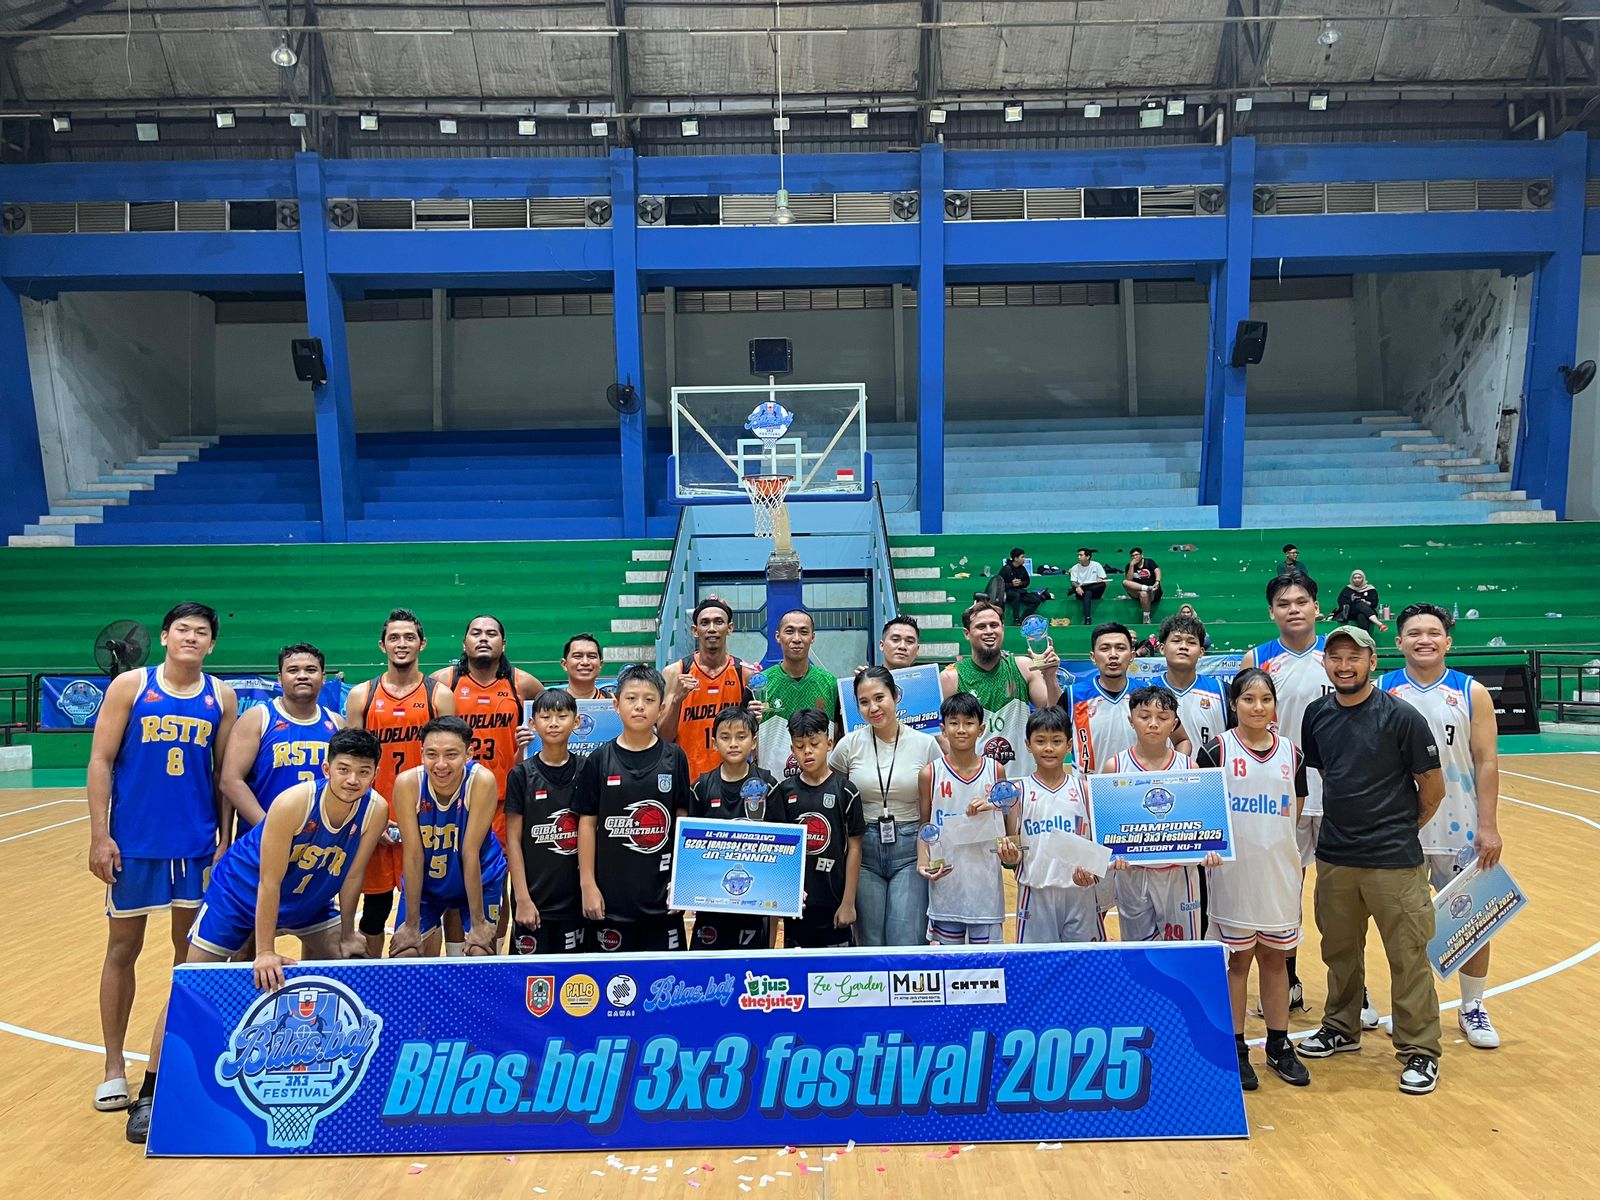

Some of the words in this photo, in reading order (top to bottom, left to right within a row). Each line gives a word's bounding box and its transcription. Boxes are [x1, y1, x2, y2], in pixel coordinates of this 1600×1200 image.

[459, 712, 514, 730] ALDELAPAN
[988, 716, 1005, 733] 10
[141, 714, 212, 748] RSTR
[370, 725, 424, 744] ALDELAPA
[1201, 727, 1209, 745] 6
[1445, 724, 1455, 745] 3
[166, 747, 184, 776] 8
[273, 741, 329, 769] RST
[392, 751, 405, 775] 7
[784, 769, 801, 777] GOA
[1233, 757, 1247, 777] 13
[940, 781, 953, 798] 14
[1030, 790, 1037, 801] 2
[533, 825, 557, 835] CIBA
[606, 818, 634, 828] CIBA
[613, 826, 665, 836] BASKETBALL
[1121, 821, 1202, 833] CHAMPIONS
[685, 838, 708, 849] 2025
[708, 840, 741, 851] Festival
[731, 832, 776, 842] CATEGORY
[1104, 833, 1142, 845] Bilas.bdj
[1143, 832, 1160, 842] 3x3
[1162, 831, 1198, 842] Festival
[1198, 829, 1222, 840] 2025
[702, 850, 777, 863] RUNNER-UP
[742, 844, 758, 853] 3x3
[758, 841, 796, 855] Bilas.bdj
[1126, 844, 1174, 853] CATEGORY
[429, 854, 447, 879] 5
[659, 853, 671, 872] 2
[815, 857, 836, 873] 89
[293, 874, 314, 894] 1
[1497, 898, 1519, 920] PUTRA
[1446, 910, 1484, 948] RUNNER
[1484, 896, 1498, 912] UP
[1475, 905, 1501, 931] Festival
[565, 928, 585, 950] 34
[668, 929, 680, 949] 2
[739, 929, 756, 945] 17
[566, 983, 595, 998] PAL8
[761, 977, 788, 992] jus
[835, 975, 886, 1003] Garden
[893, 972, 940, 993] MJU
[643, 973, 736, 1012] Bilas.bdj
[741, 994, 803, 1010] thejuicy
[221, 1015, 378, 1079] Bilas.bdj
[285, 1076, 309, 1087] 3X3
[382, 1038, 629, 1125] Bilas.bdj
[634, 1035, 749, 1111] 3x3
[760, 1030, 987, 1109] festival
[996, 1025, 1145, 1102] 2025
[263, 1088, 330, 1099] FESTIVAL
